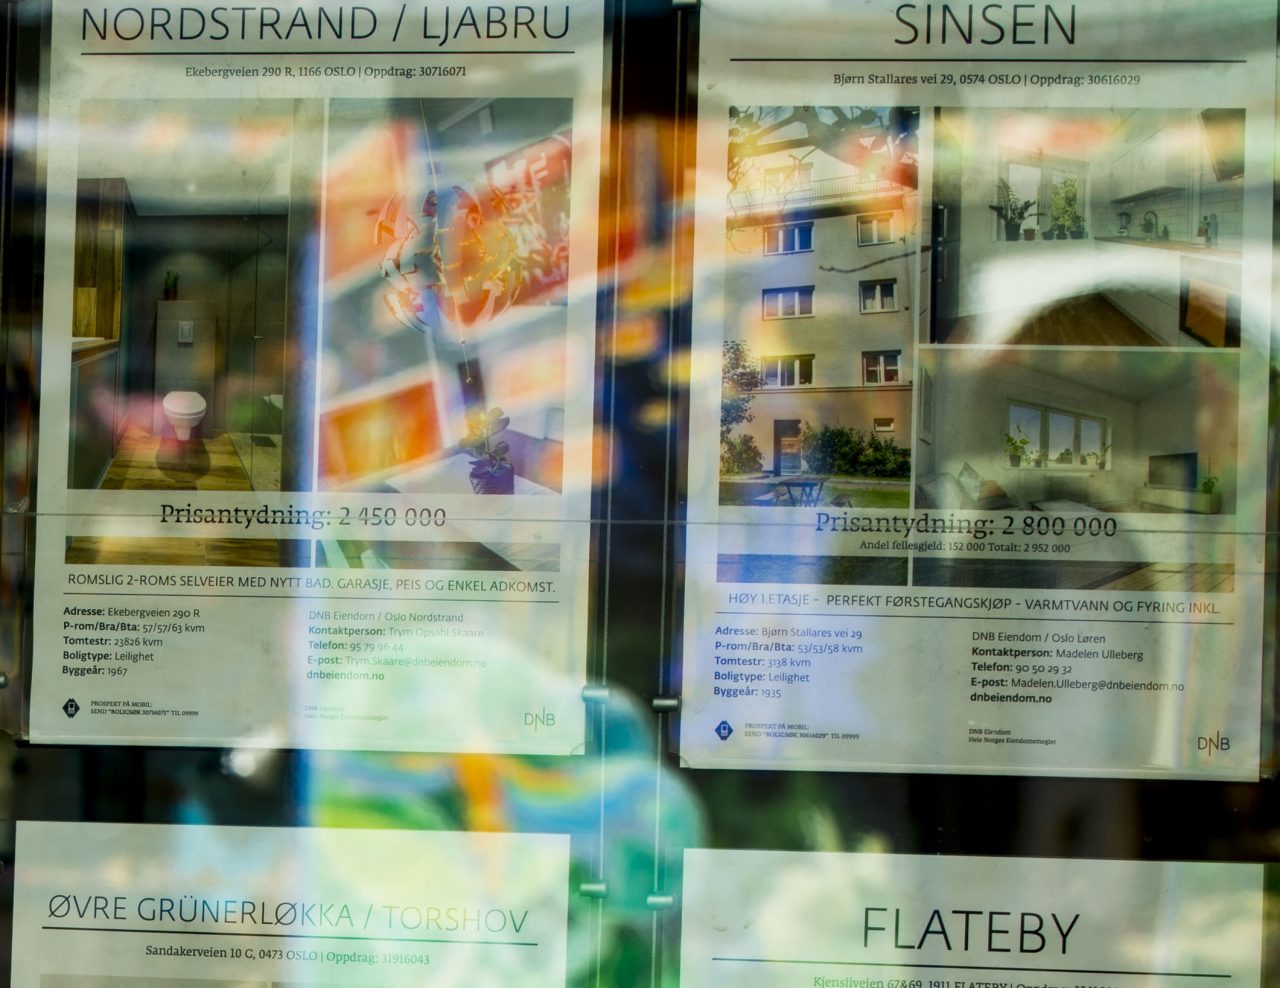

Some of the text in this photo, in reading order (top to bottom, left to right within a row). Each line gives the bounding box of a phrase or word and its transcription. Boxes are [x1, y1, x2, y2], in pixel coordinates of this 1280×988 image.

[81, 3, 569, 45] NORDSTRAND / LJABRU
[894, 3, 1075, 44] SINSEN
[185, 66, 259, 78] Ekebergveien
[261, 66, 281, 76] 290
[284, 66, 295, 77] R,
[298, 66, 321, 76] 1166
[324, 66, 355, 76] OSLO
[363, 66, 416, 78] Oppdrag:
[419, 65, 466, 76] 30716071
[833, 73, 864, 85] Bjørn
[867, 73, 917, 84] Stallares
[920, 73, 937, 84] vei
[940, 73, 956, 86] 29,
[959, 73, 985, 84] 0574
[987, 74, 1021, 84] OSLO
[1029, 73, 1084, 86] Oppdrag:
[1087, 74, 1140, 85] 30616029
[159, 503, 446, 529] Prisantydning: 2 450 000
[815, 511, 1118, 540] Prisantydning: 2 800 000
[62, 650, 154, 663] Boligtype: Leilighet
[61, 664, 128, 676] Byggeår: 1967
[306, 670, 384, 680] dnbeiendom.no
[713, 686, 781, 698] Byggeår: 1935
[969, 692, 1052, 703] dnbeiendom.no
[523, 706, 555, 731] DNB
[1197, 730, 1230, 756] DNB
[48, 894, 529, 933] ØVRE GRÜNERLØKKA / TORSHOV
[863, 906, 1080, 954] FLATEBY
[145, 945, 227, 958] Sandakerveien
[230, 948, 242, 958] 10
[258, 949, 283, 959] 0473
[285, 950, 318, 961] OSLO
[326, 951, 378, 964] Oppdrag:
[813, 976, 884, 988] Kjensliveien
